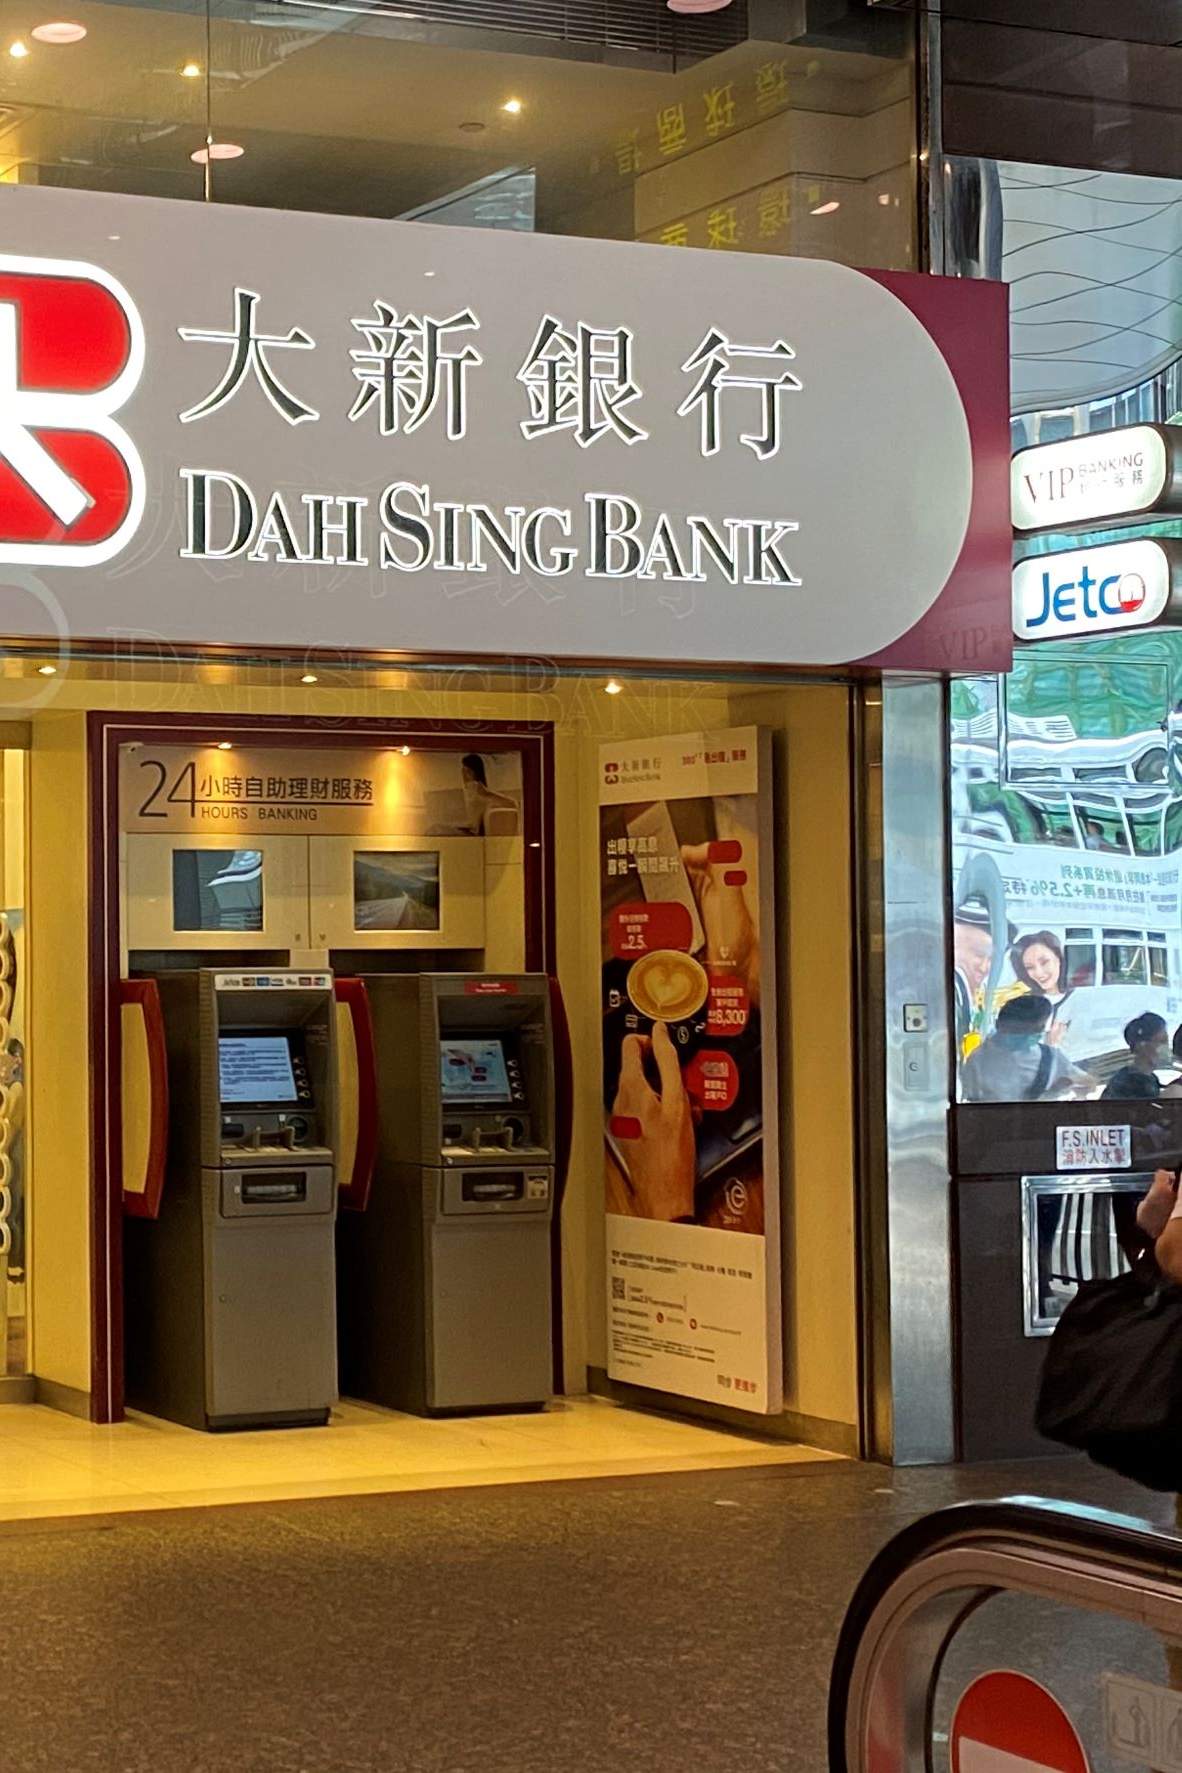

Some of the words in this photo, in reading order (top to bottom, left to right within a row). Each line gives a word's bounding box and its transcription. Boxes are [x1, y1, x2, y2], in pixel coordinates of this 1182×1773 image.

[177, 287, 803, 460] 大新銀行
[1023, 466, 1075, 504] VIP
[179, 468, 368, 569] DAH
[379, 482, 577, 576] SING
[584, 493, 803, 586] BANK
[137, 760, 197, 818] 24
[199, 774, 374, 801] 小時自助理財服務
[201, 806, 249, 820] HOURS
[258, 807, 318, 822] BANKING
